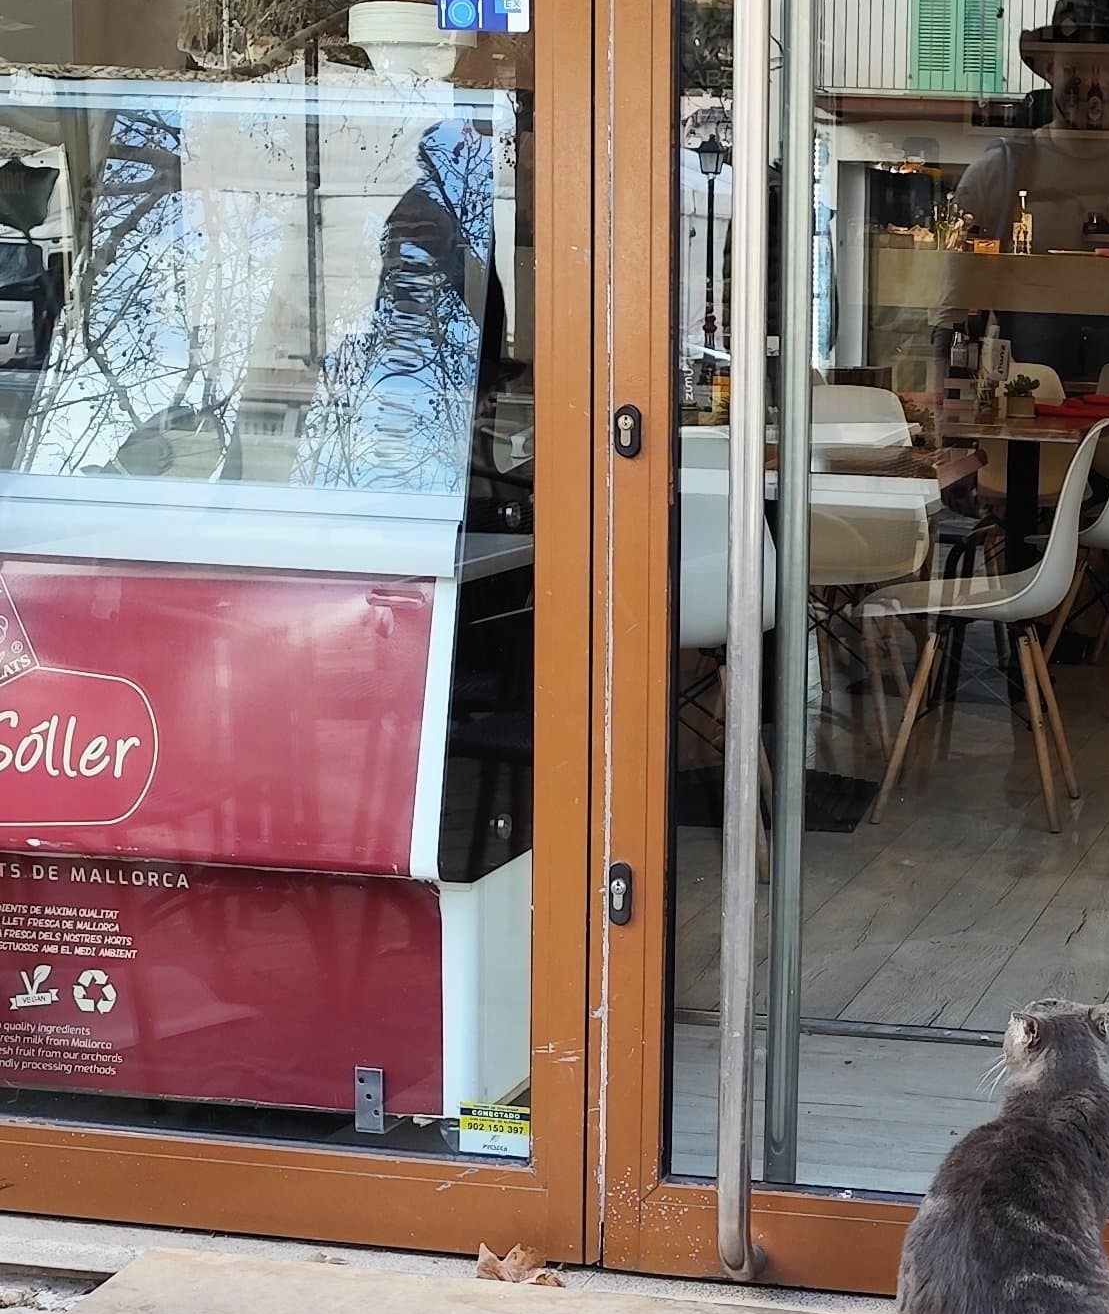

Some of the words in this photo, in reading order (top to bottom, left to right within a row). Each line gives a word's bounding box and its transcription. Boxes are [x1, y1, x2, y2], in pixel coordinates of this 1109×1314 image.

[505, 0, 521, 8] EX
[33, 865, 59, 881] DE
[71, 867, 190, 889] MALLORCA
[30, 905, 42, 915] DE
[79, 908, 119, 920] QUALITAT
[2, 916, 25, 927] LLET
[27, 918, 60, 929] FRESCA
[62, 920, 74, 930] DE
[75, 921, 120, 933] MALLORCA
[3, 929, 37, 940] FRESCA
[38, 931, 61, 942] DELS
[62, 933, 102, 945] NOSTRES
[104, 935, 133, 946] HORTS
[41, 944, 58, 954] AMB
[60, 945, 72, 955] EL
[74, 946, 96, 957] MEDI
[98, 947, 138, 960] AMBIENT
[22, 995, 46, 1004] VEGAN
[3, 1022, 36, 1033] quality
[38, 1022, 90, 1035] ingredients
[22, 1034, 43, 1045] milk
[45, 1035, 69, 1046] from
[71, 1037, 112, 1049] Mallorca
[15, 1046, 35, 1058] fruit
[37, 1047, 61, 1059] from
[62, 1050, 79, 1060] our
[81, 1051, 123, 1063] orchards
[21, 1061, 73, 1075] processing
[74, 1063, 117, 1076] methods
[471, 1109, 521, 1120] CONECTADO
[467, 1122, 485, 1131] 902
[507, 1125, 524, 1134] 397
